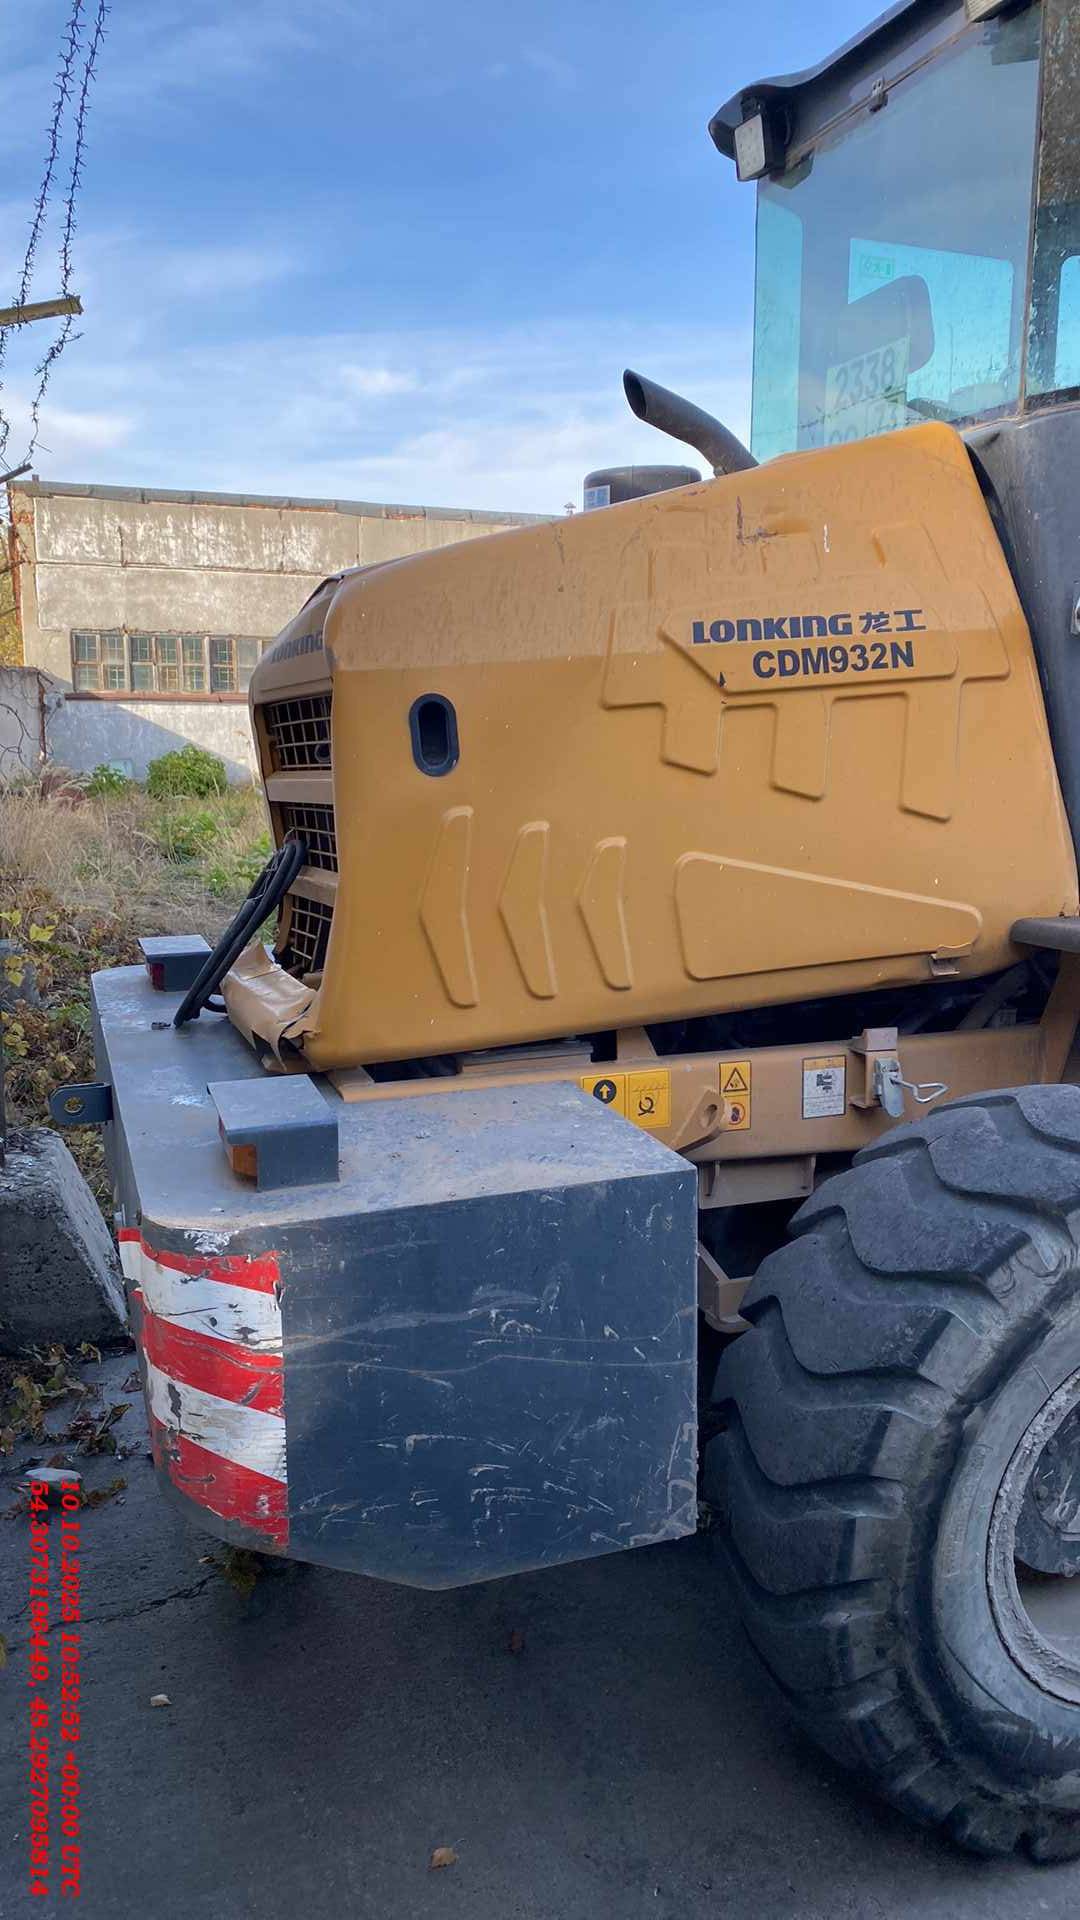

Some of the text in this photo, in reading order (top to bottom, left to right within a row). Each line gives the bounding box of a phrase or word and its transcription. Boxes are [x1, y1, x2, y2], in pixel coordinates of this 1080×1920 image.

[693, 609, 926, 644] LONKING 龙工
[752, 641, 914, 679] CDM932N
